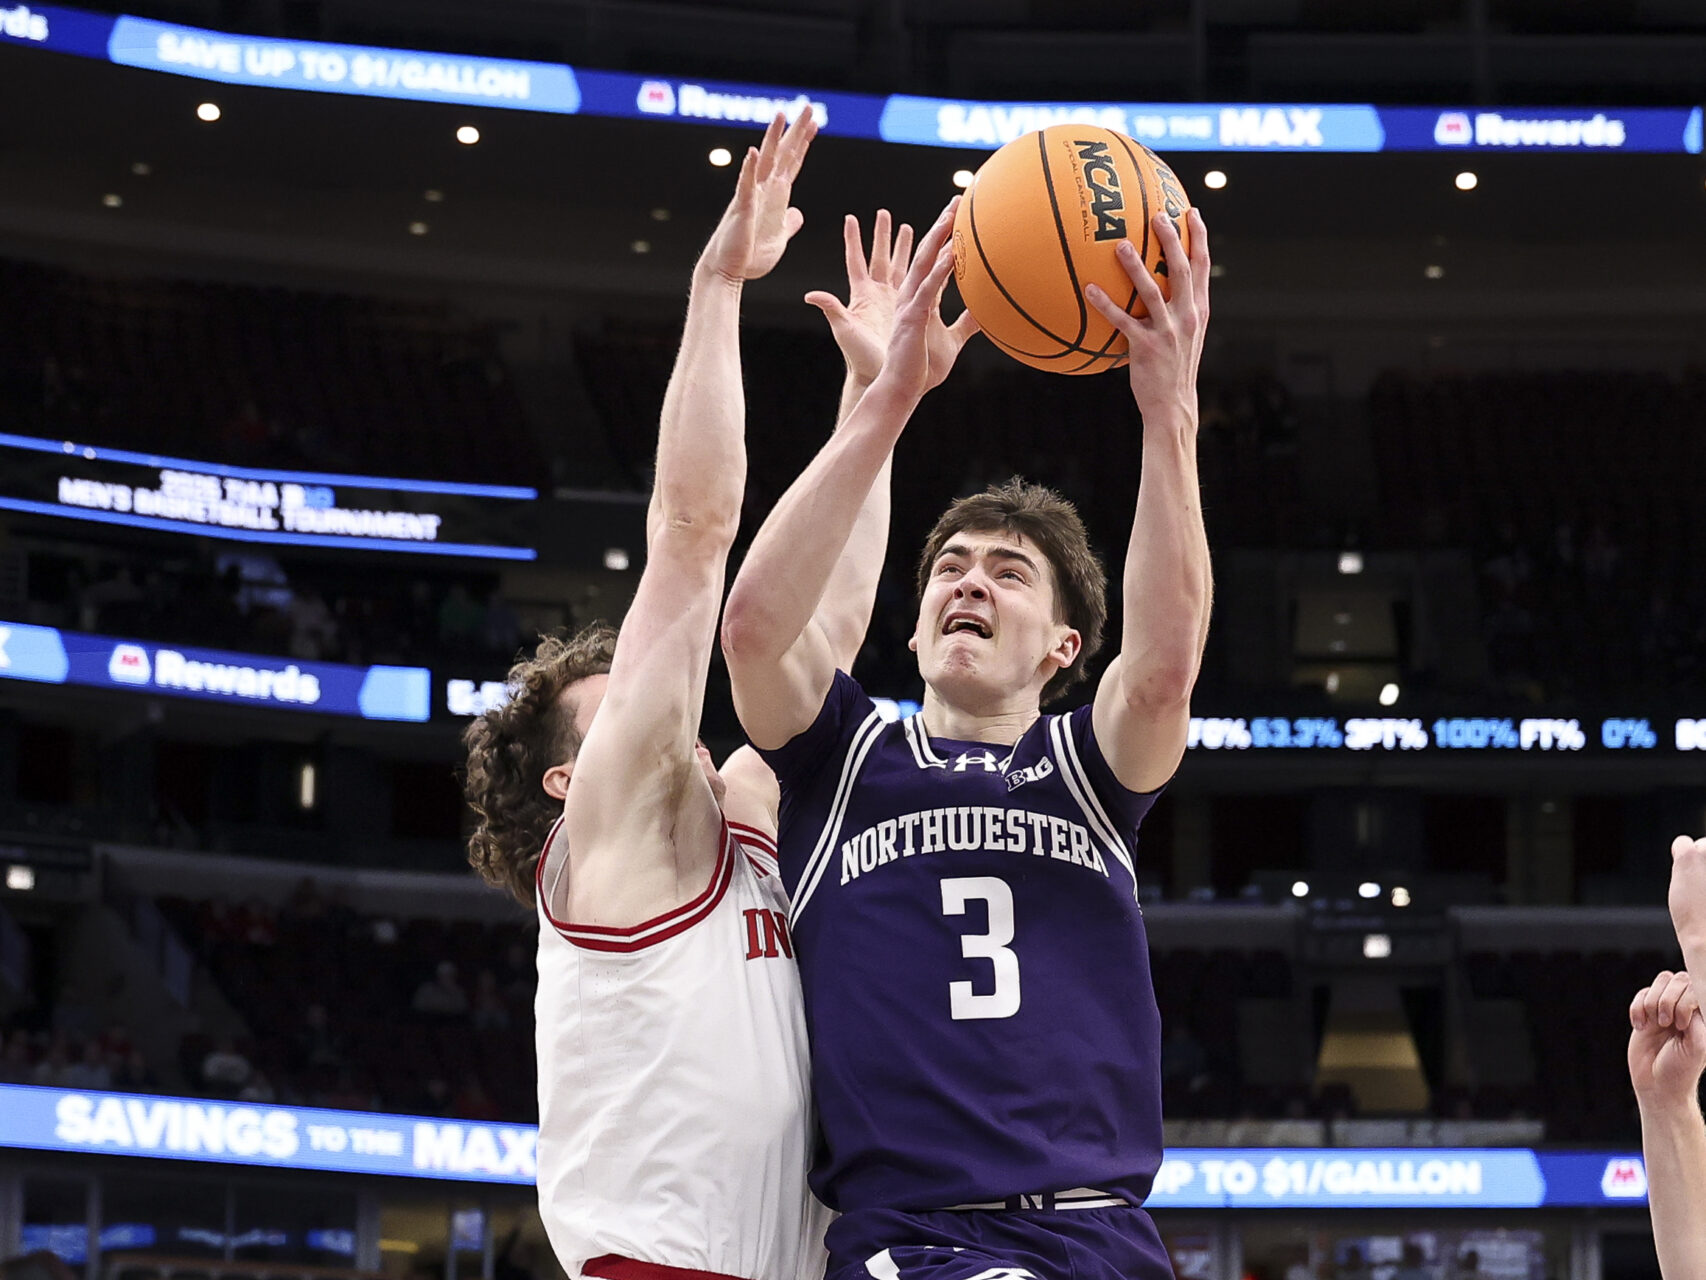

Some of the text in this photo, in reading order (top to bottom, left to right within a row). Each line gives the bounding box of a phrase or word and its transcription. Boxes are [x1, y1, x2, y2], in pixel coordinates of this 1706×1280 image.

[156, 32, 530, 99] SAVE UP TO $1/GALLON
[1219, 108, 1324, 147] MAX
[1475, 113, 1626, 147] Rewards
[1073, 140, 1127, 242] NCAA
[1075, 176, 1087, 207] GAME
[1081, 210, 1091, 242] BALL
[58, 476, 132, 512] MEN'S
[281, 506, 441, 541] TOURNAMENT
[154, 649, 321, 704] Rewards
[1433, 717, 1519, 748] 100%
[1520, 718, 1586, 750] FT%
[1601, 718, 1657, 748] 0%
[840, 806, 1110, 886] NORTHWESTERN
[940, 876, 1021, 1021] 3
[56, 1094, 299, 1159] SAVINGS
[307, 1124, 348, 1151] TO
[412, 1122, 538, 1176] MAX
[1200, 1160, 1257, 1195] TO
[1262, 1156, 1482, 1199] $1/GALLON
